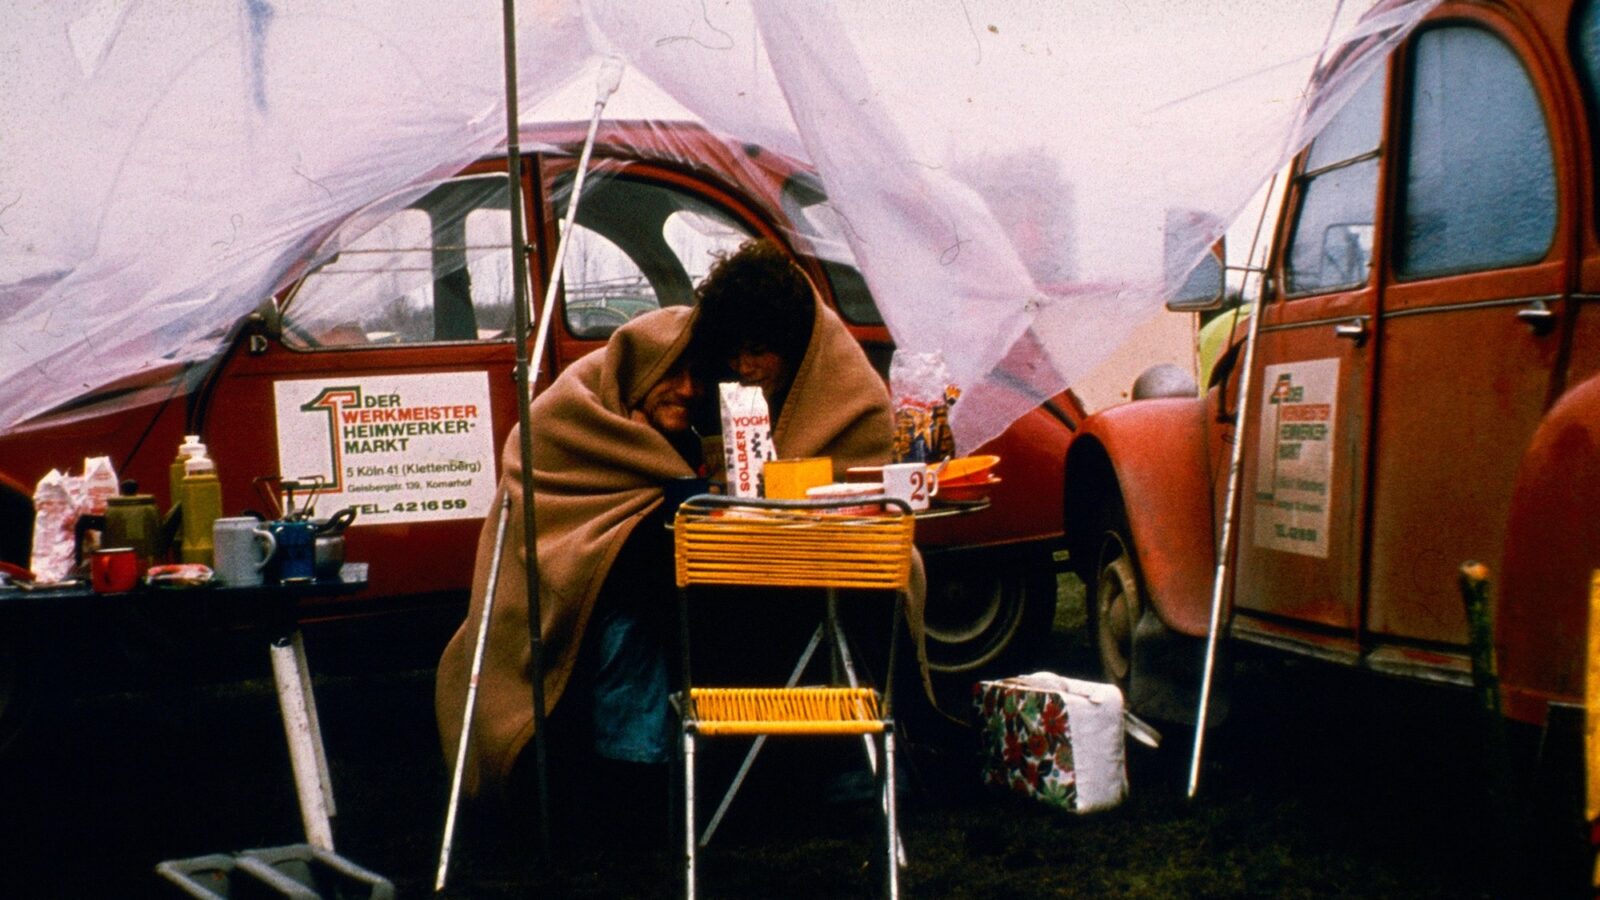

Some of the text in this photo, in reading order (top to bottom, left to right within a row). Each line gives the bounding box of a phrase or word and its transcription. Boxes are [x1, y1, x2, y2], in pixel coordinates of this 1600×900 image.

[364, 394, 401, 408] DER
[342, 405, 477, 424] WERKMEISTER
[343, 420, 476, 439] HEIMWERKER-
[344, 438, 410, 454] MARKT
[346, 460, 482, 478] 5 Köln 41 (Klettenberg)
[349, 503, 390, 515] TEL.
